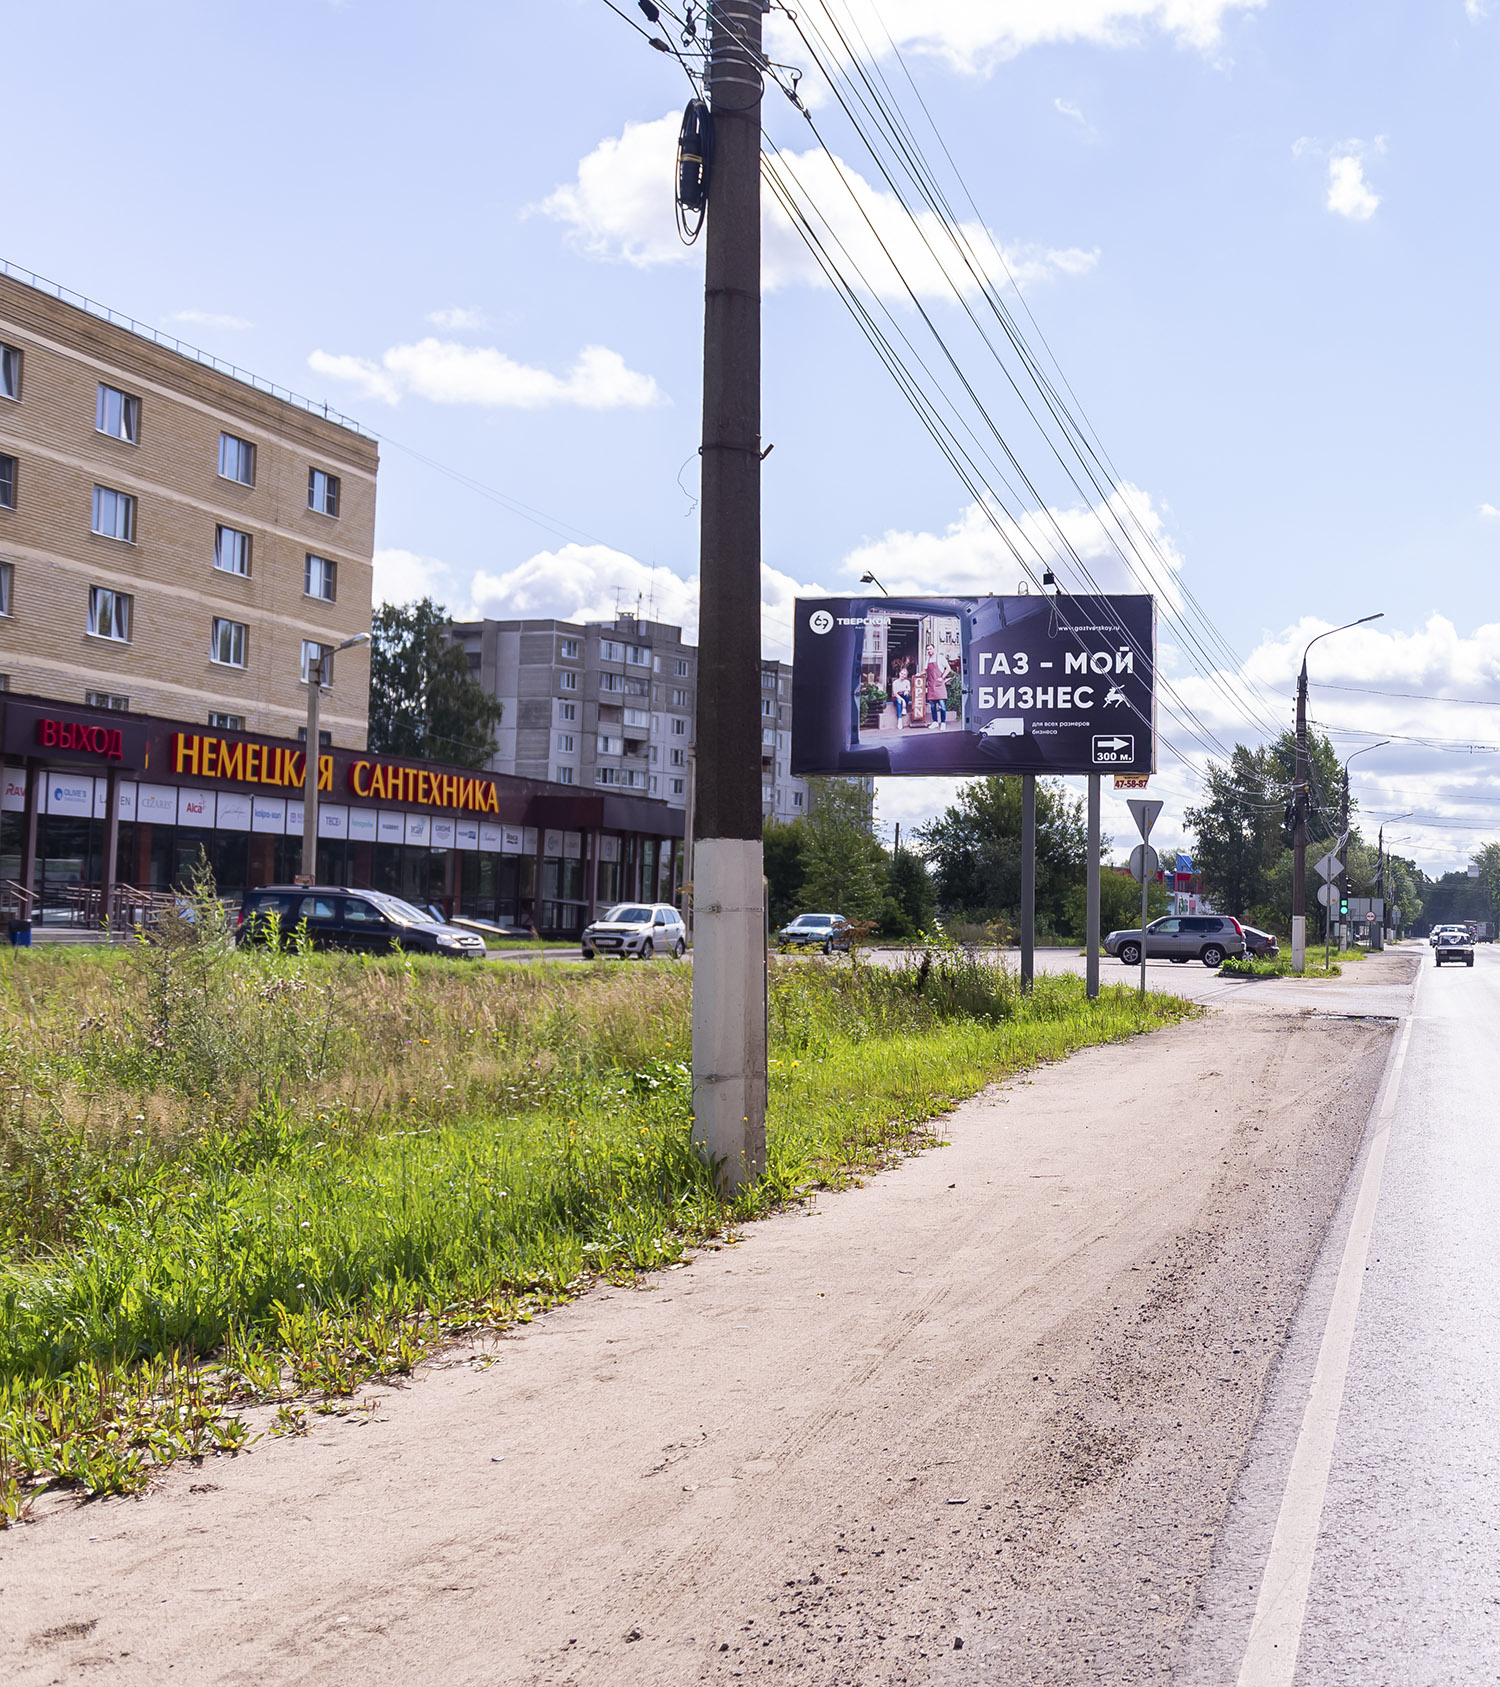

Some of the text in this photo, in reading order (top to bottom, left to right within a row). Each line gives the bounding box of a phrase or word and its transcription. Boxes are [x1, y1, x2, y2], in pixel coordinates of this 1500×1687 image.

[978, 652, 1029, 675] ГАЗ
[1064, 646, 1135, 675] МОЙ
[914, 677, 924, 718] OPEN
[978, 686, 1095, 710] БИЗНЕС
[38, 718, 123, 761] ВЫХОД
[1097, 752, 1117, 761] 300
[5, 783, 26, 797] RAV
[351, 760, 500, 814] САНТЕХНИКА
[1115, 780, 1148, 788] 47-58-87
